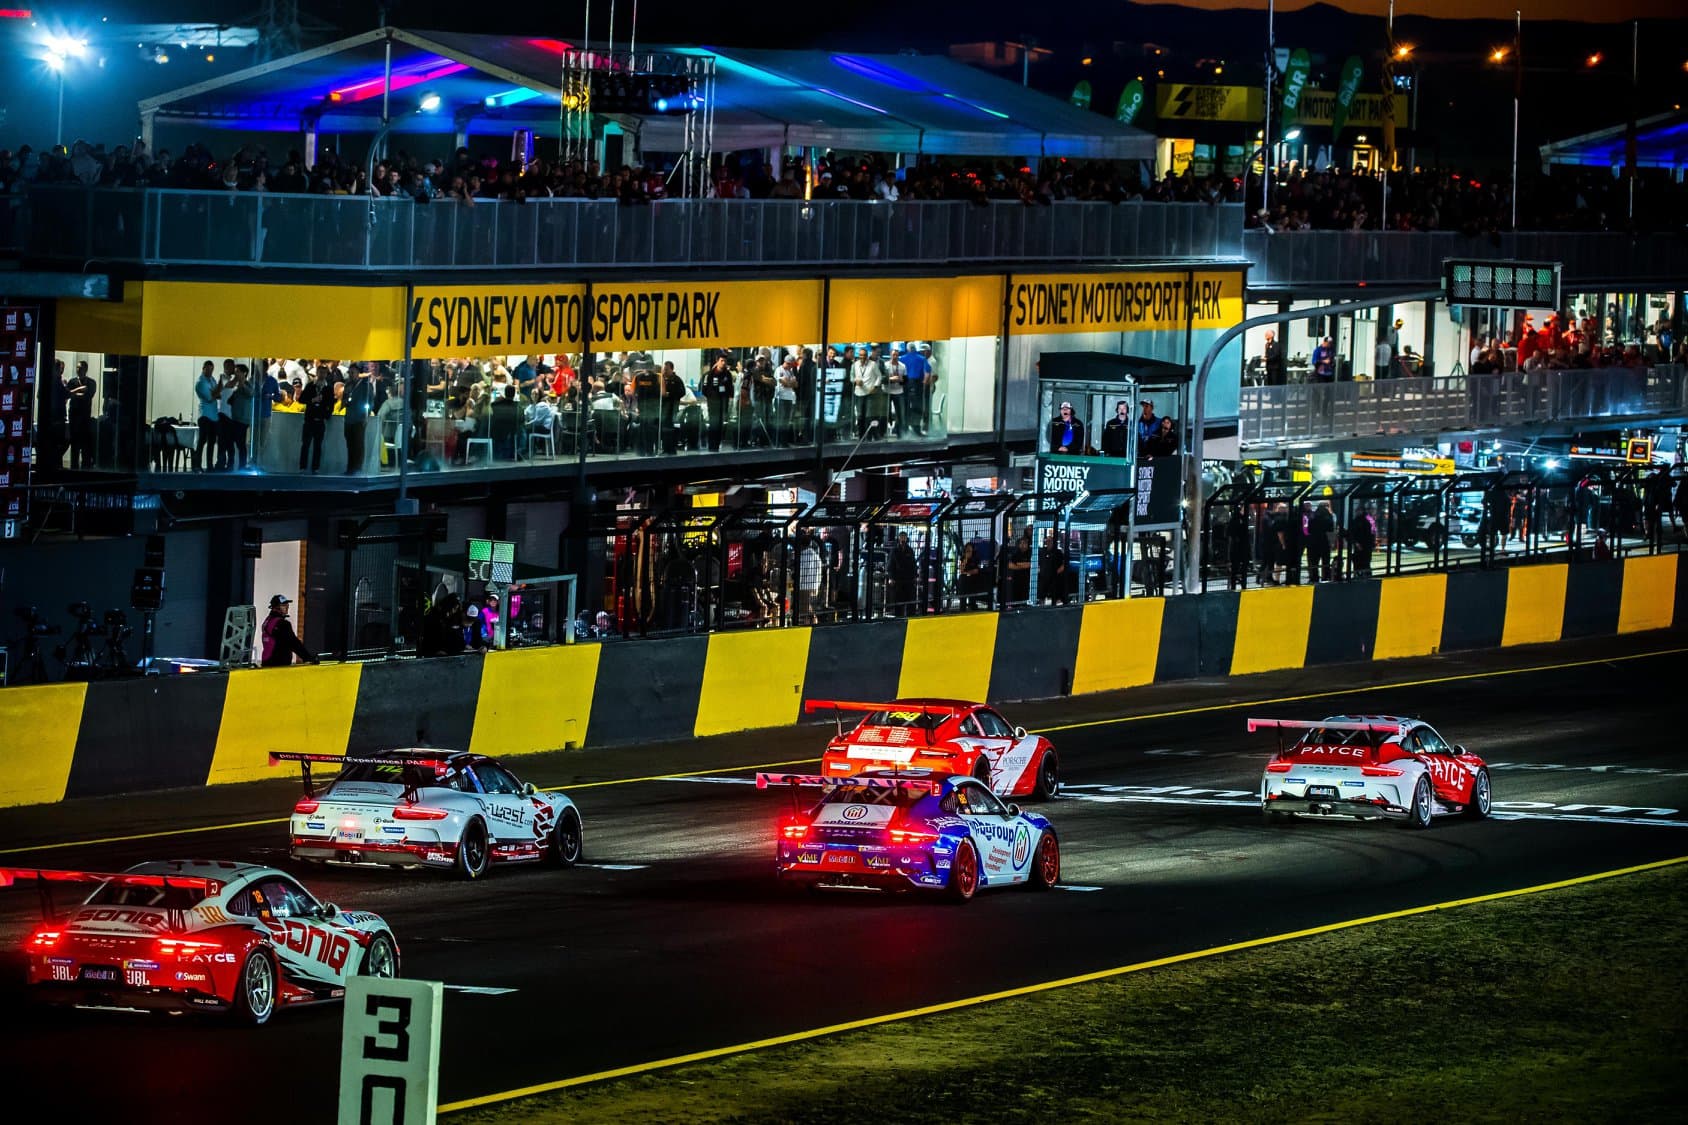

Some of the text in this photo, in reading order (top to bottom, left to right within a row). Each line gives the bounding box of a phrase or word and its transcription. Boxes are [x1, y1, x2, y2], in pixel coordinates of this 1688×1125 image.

[1284, 70, 1307, 109] BAR
[1016, 280, 1222, 326] SYDNEY MOTORSPORT PARK
[427, 291, 721, 348] SYDNEY MOTORSPORT PARK
[1044, 464, 1090, 480] SYDNEY
[1138, 466, 1154, 480] SYDNEY
[1043, 477, 1084, 492] MOTOR
[1137, 479, 1152, 492] MOTOR
[1300, 746, 1365, 757] PAYCE
[1420, 755, 1466, 791] PAYCE
[53, 965, 74, 981] JBL
[127, 969, 150, 987] JBL
[183, 971, 206, 982] Swann
